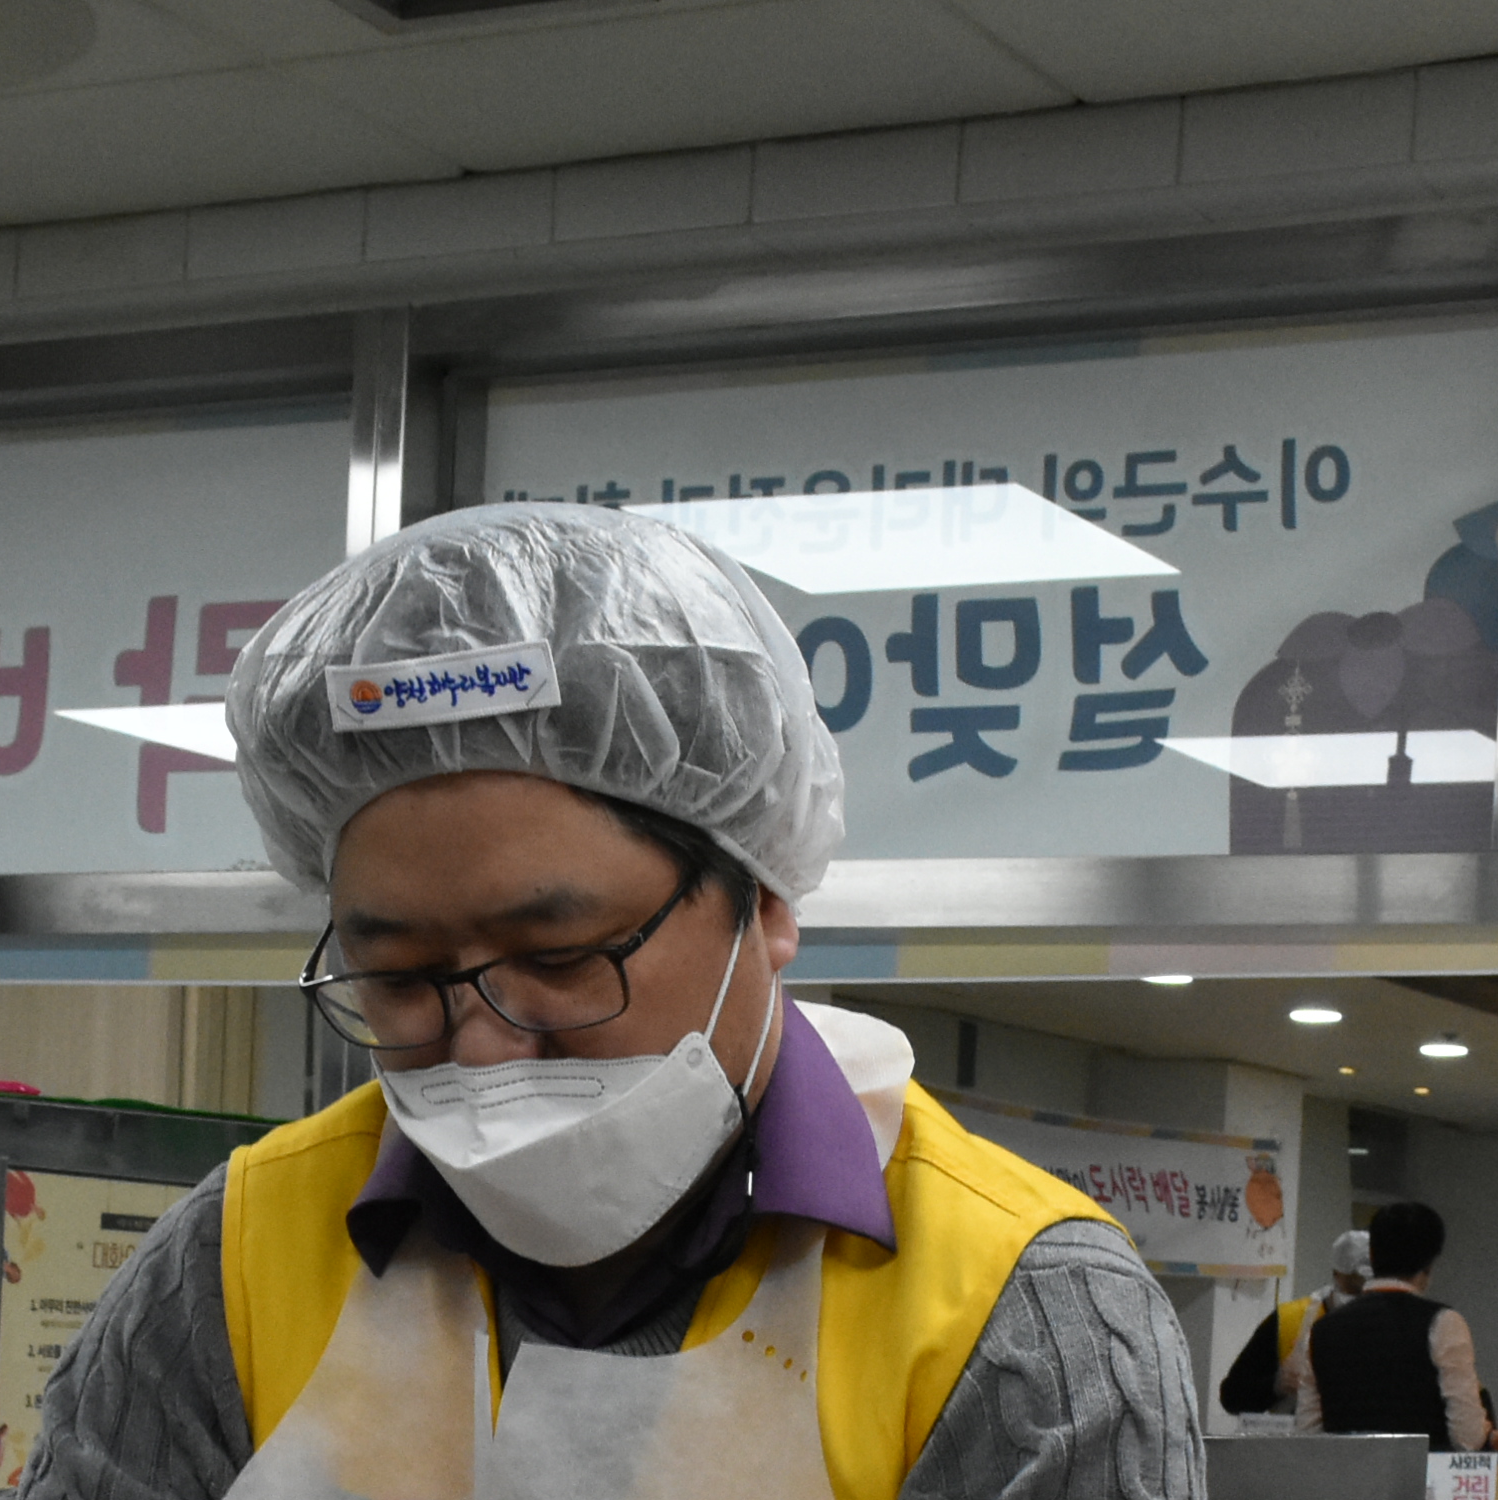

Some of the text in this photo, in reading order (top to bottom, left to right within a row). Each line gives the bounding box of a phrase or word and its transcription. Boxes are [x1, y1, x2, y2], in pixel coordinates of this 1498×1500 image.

[1089, 1162, 1150, 1214] 도시락
[1151, 1168, 1191, 1218] 배달
[1449, 1454, 1491, 1470] 사회적
[1452, 1475, 1489, 1494] 거리
